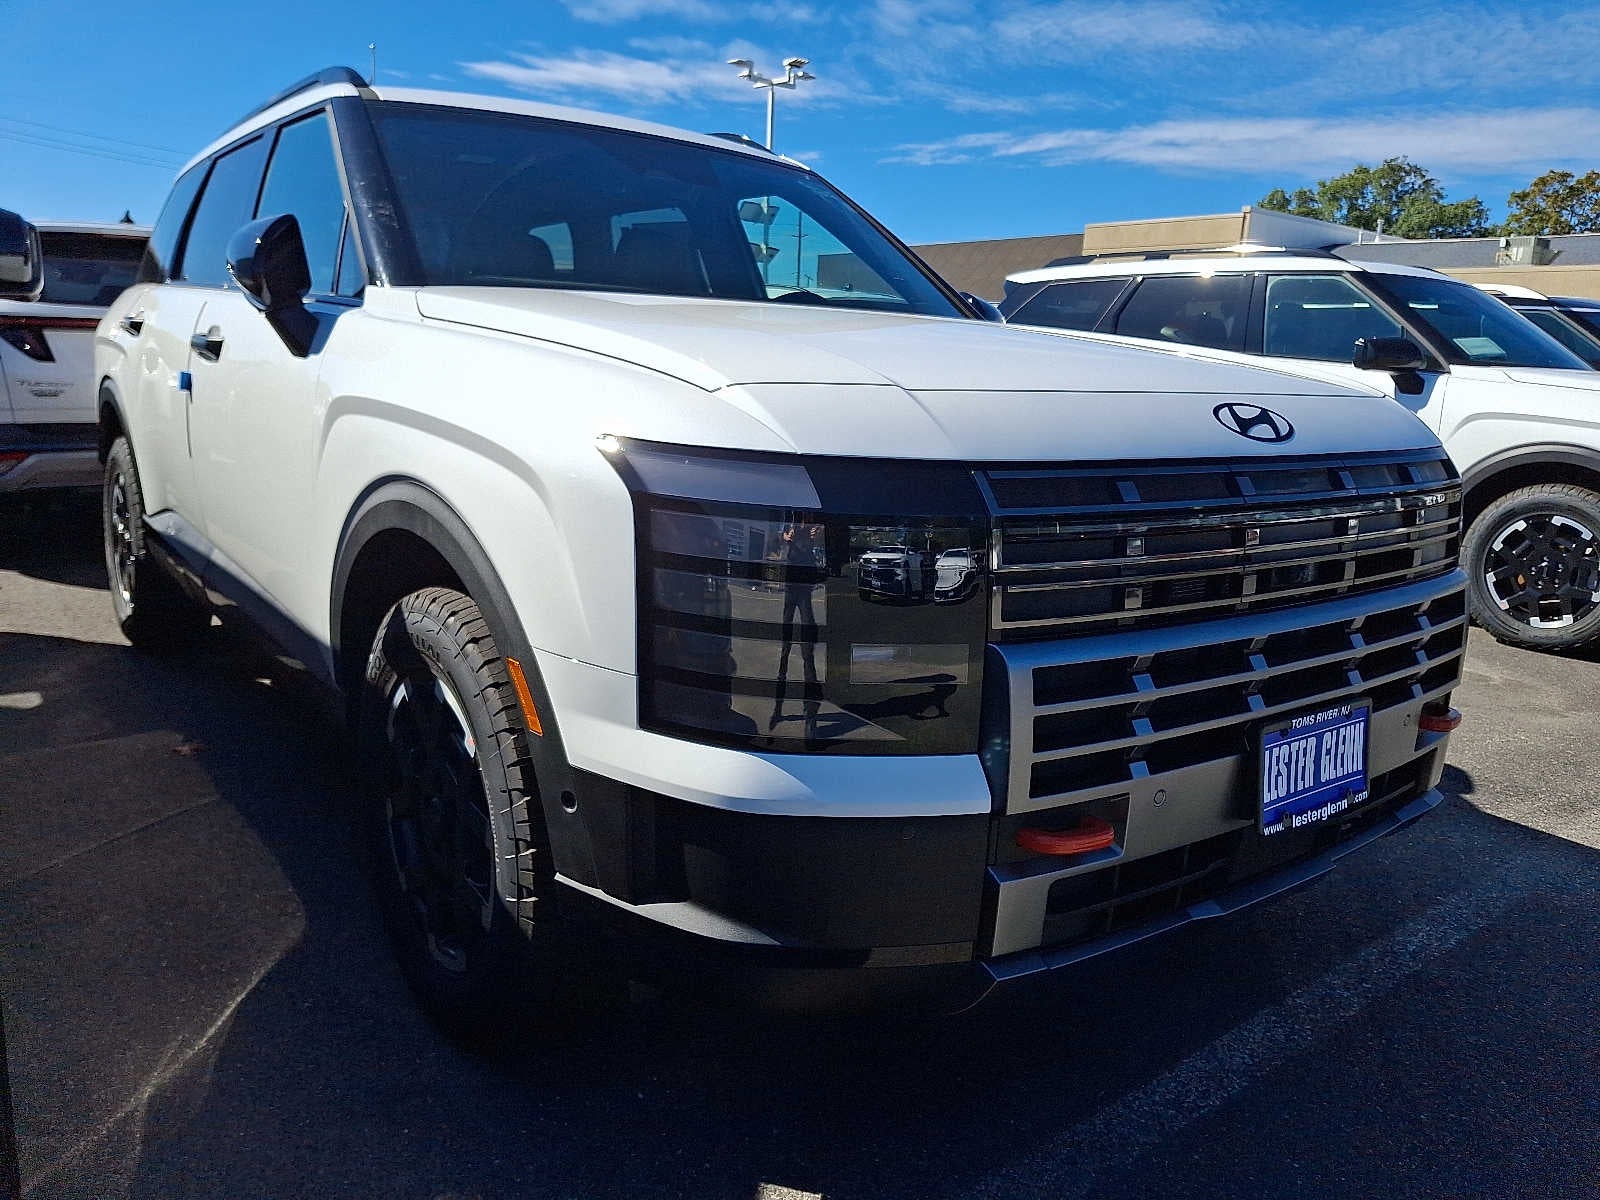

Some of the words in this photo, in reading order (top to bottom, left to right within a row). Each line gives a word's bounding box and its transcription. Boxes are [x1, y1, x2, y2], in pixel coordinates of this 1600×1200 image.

[1291, 714, 1315, 729] TOMS
[1340, 704, 1352, 716] NJ
[1263, 736, 1317, 803] LESTER
[1320, 721, 1365, 783] GLENN
